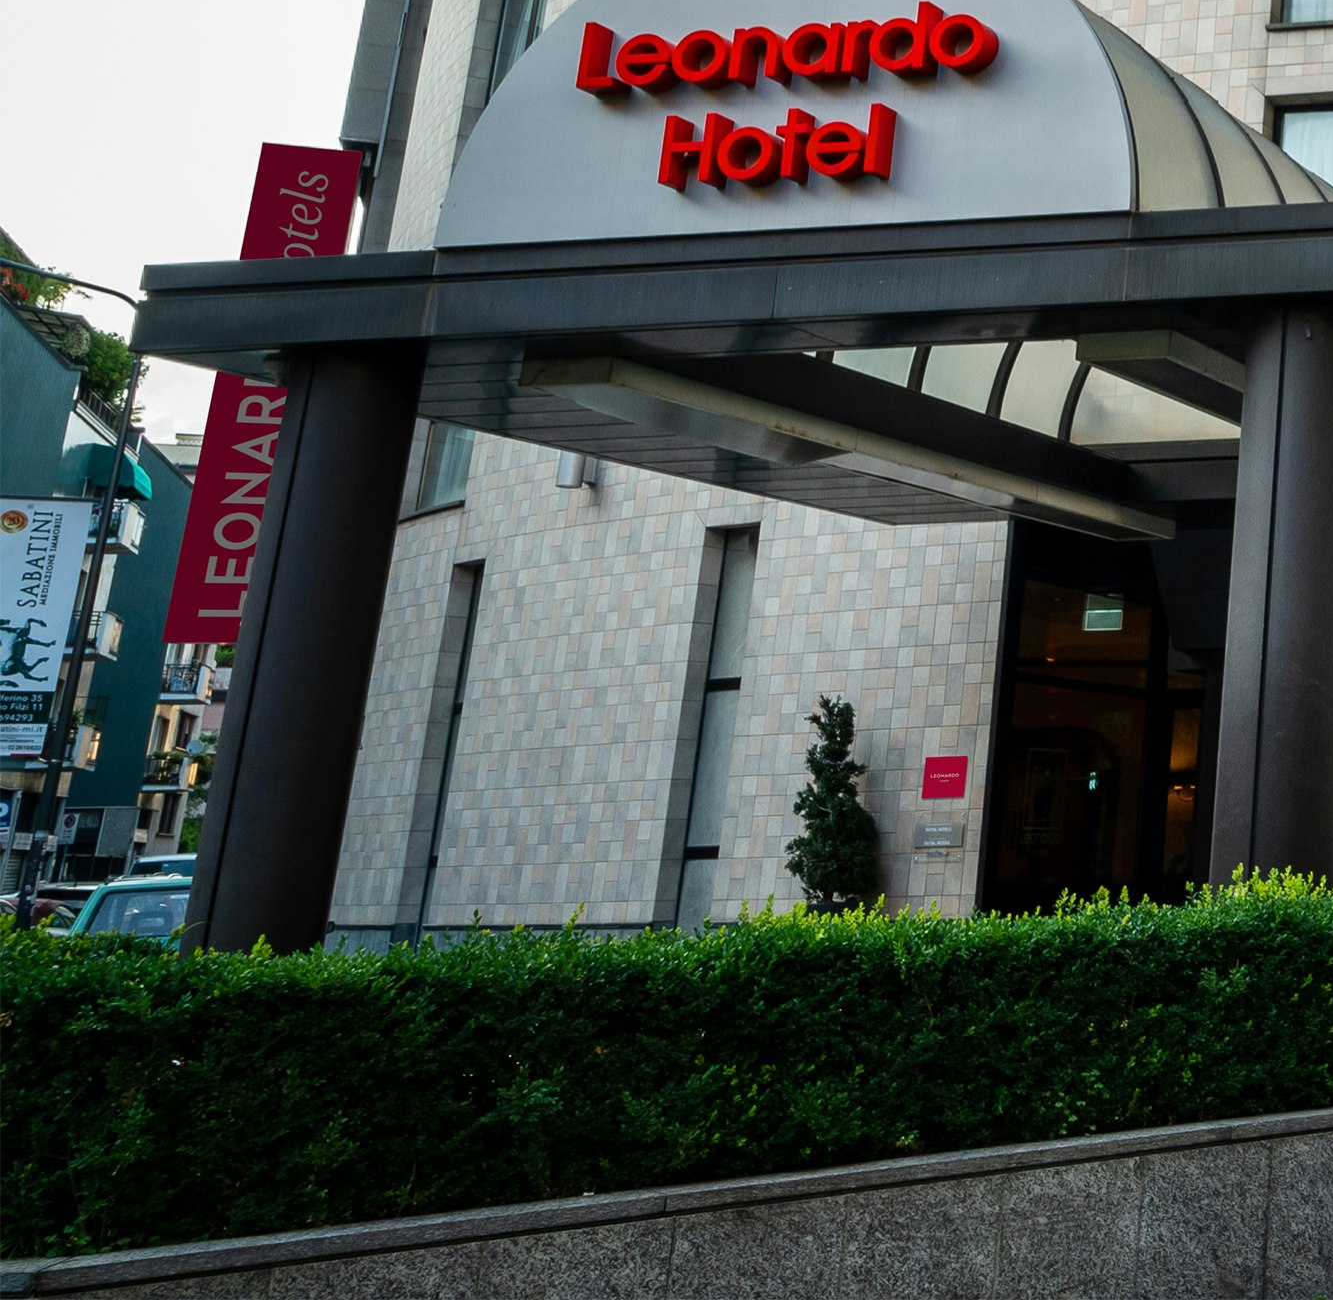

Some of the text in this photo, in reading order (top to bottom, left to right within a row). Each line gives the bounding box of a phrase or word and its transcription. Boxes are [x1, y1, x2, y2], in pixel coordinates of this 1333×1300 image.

[576, 1, 999, 96] Leonardo
[658, 103, 897, 191] Hotel
[197, 170, 329, 618] LEONAR otels
[16, 511, 54, 608] SABATINI
[39, 513, 63, 605] MEDIAZIONE IMMOBILI
[31, 694, 43, 702] 35
